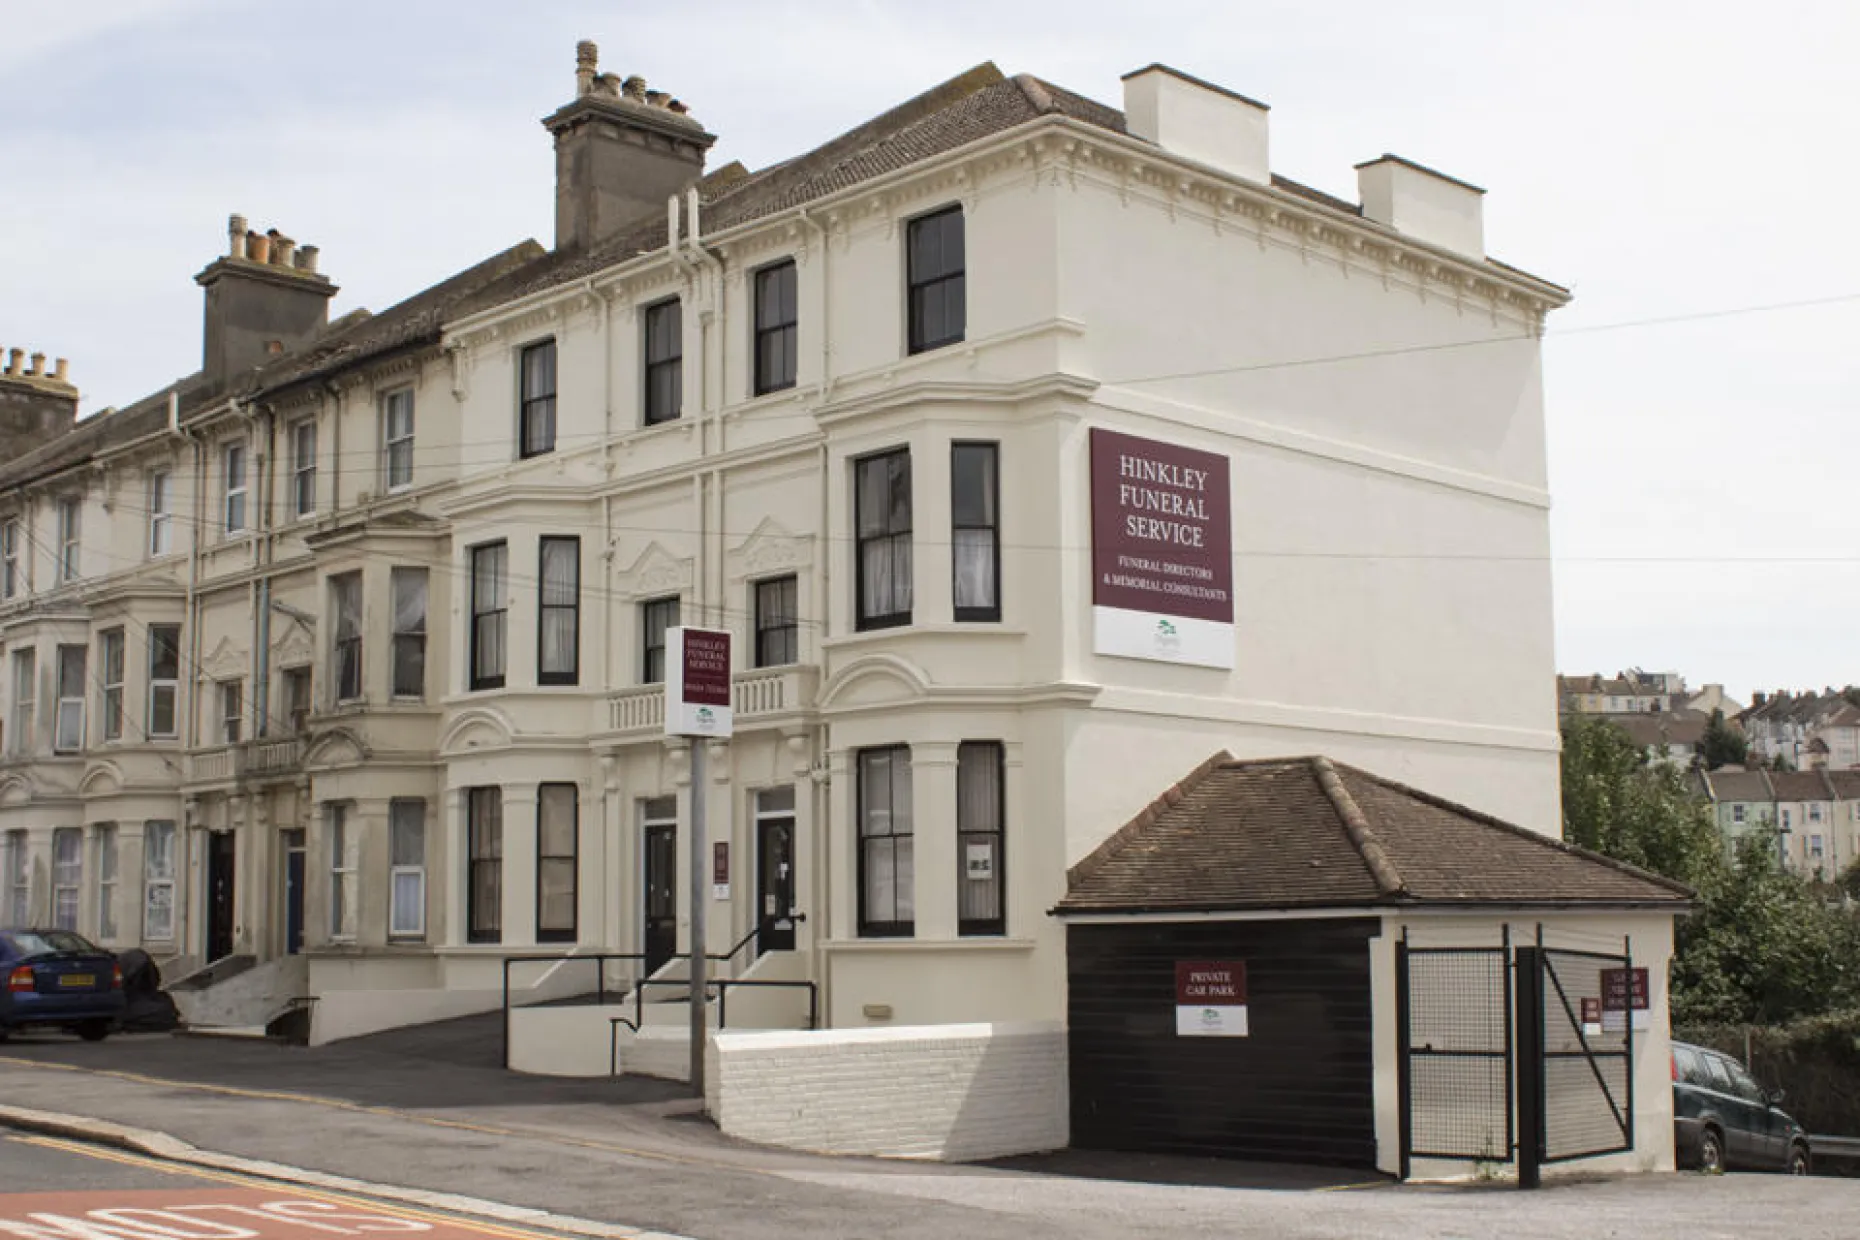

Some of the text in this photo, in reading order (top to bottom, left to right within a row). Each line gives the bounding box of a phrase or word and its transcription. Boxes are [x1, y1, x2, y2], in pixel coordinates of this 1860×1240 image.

[1120, 454, 1209, 491] HINKLEY
[1120, 483, 1210, 520] FUNERAL
[1126, 514, 1204, 547] SERVICE
[1118, 555, 1213, 581] FUNERAL DIRECTORS
[1111, 573, 1163, 592] MEMORIAL
[1163, 581, 1227, 602] CONSULTANTS
[1185, 984, 1236, 997] CAR PARK
[1190, 971, 1232, 983] PRIVATE
